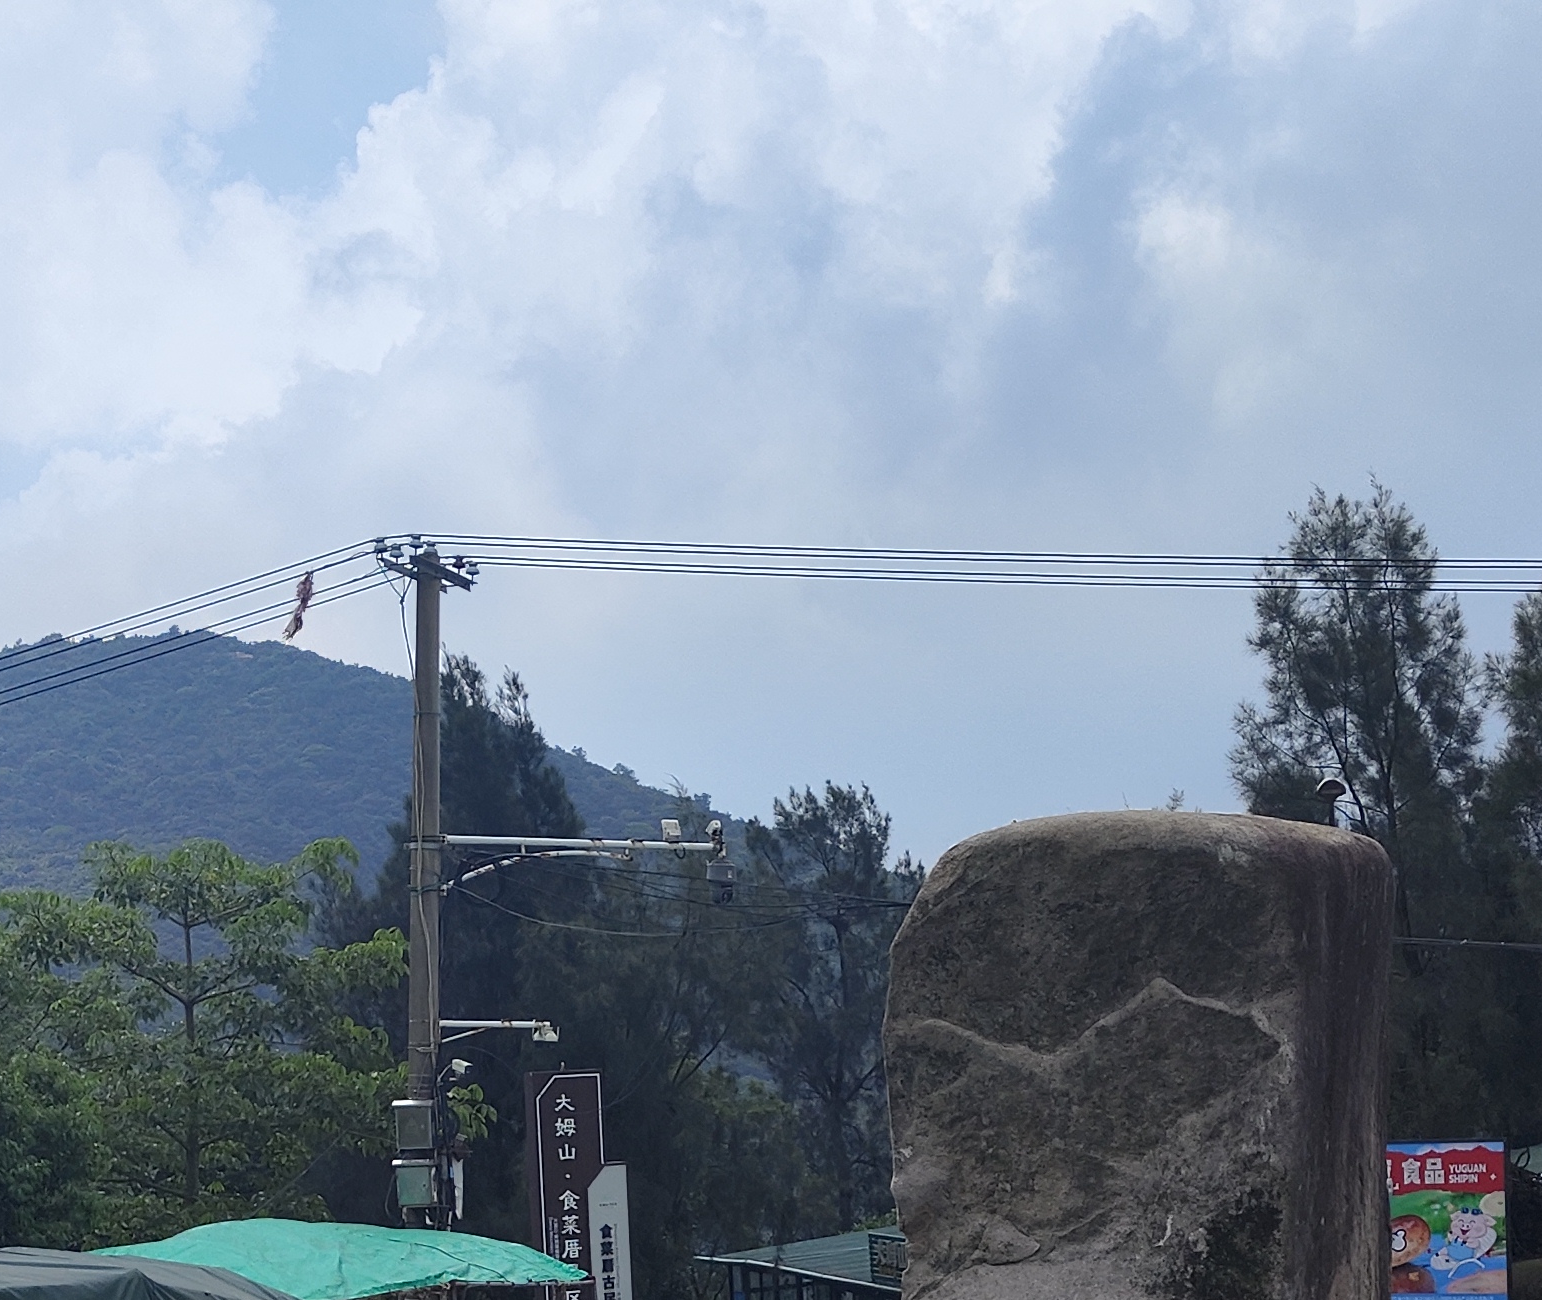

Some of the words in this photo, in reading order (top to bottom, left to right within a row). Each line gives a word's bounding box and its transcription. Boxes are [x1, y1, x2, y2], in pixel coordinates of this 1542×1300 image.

[1448, 1163, 1487, 1173] YUGUAN
[1386, 1158, 1445, 1193] 食品
[1448, 1174, 1478, 1184] SHIPIN
